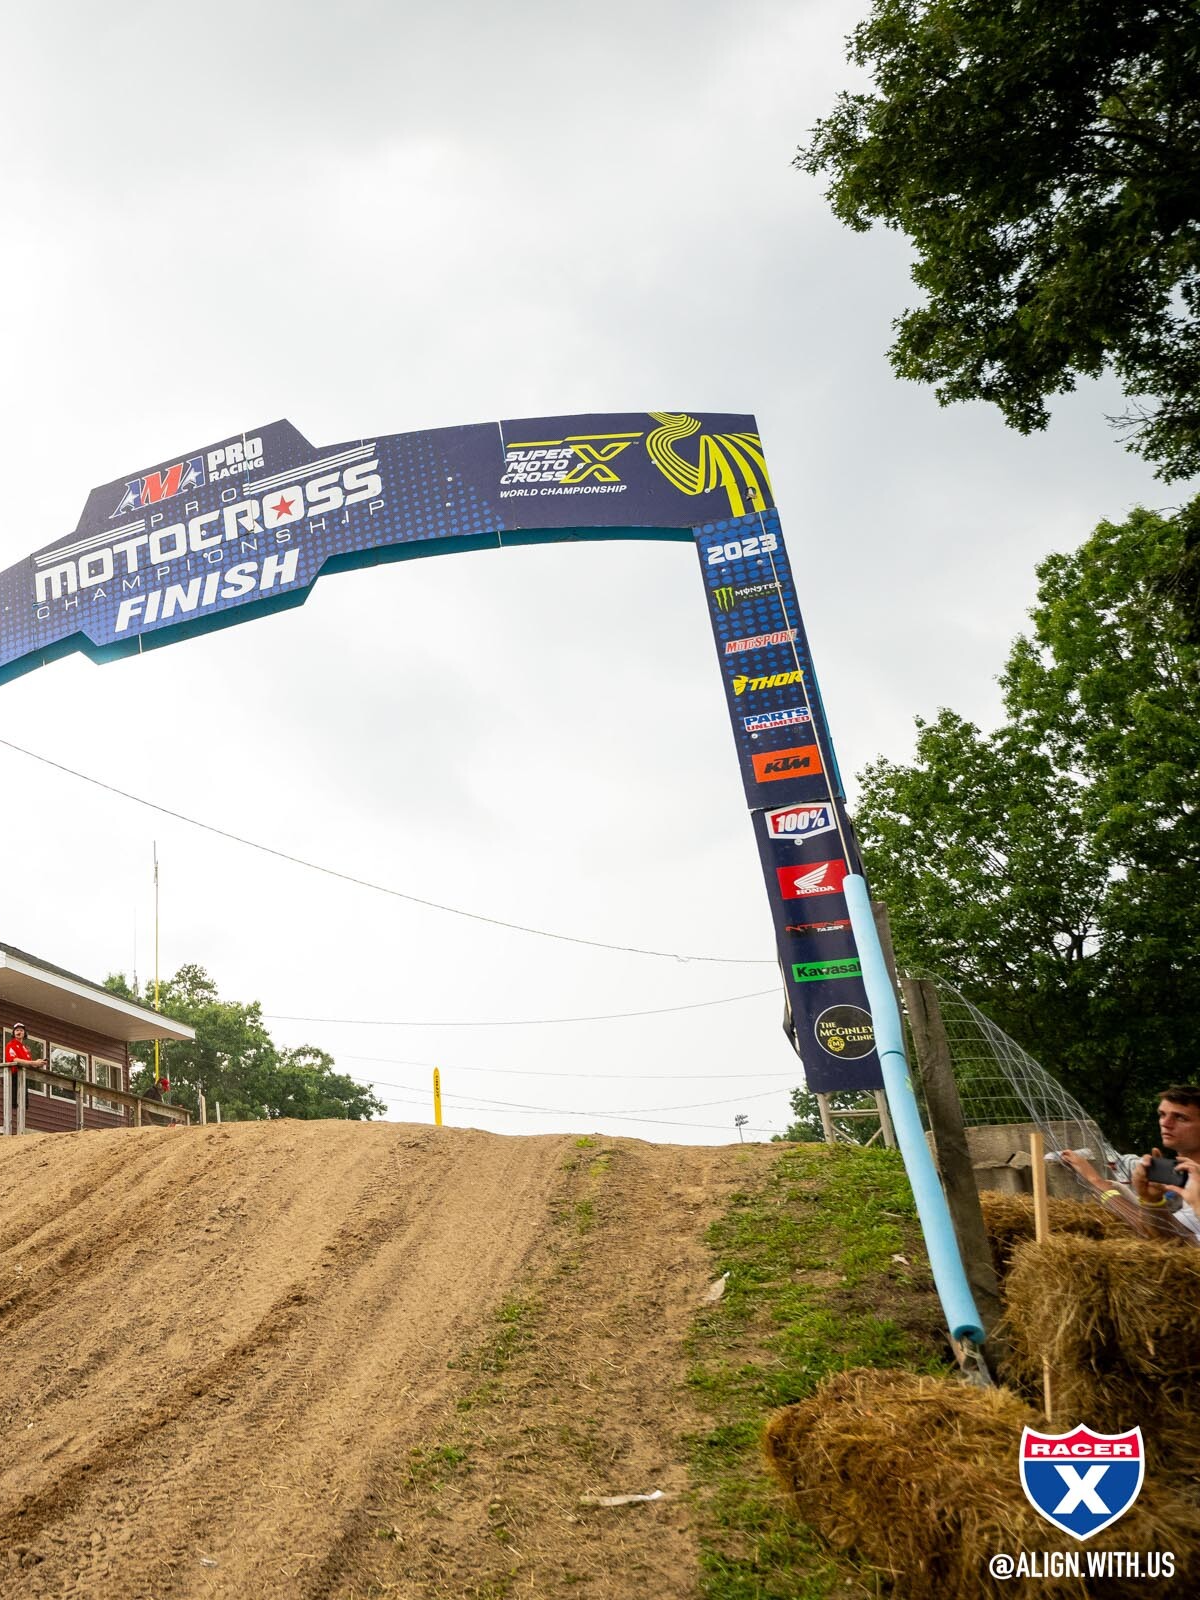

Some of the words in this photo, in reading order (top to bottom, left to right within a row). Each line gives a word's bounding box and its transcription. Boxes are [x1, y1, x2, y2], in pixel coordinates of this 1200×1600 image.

[207, 437, 263, 472] PRO
[506, 448, 574, 462] SUPER
[209, 457, 265, 483] RACING
[507, 459, 569, 474] MOTO
[500, 470, 569, 485] CROSS
[108, 455, 206, 519] AMA
[500, 488, 538, 498] WORLD
[540, 485, 628, 497] CHAMPIONSHIP
[35, 459, 383, 603] MOTOCROSS
[707, 533, 778, 565] 2023
[36, 499, 385, 620] CHAMPIONSHIP
[114, 548, 300, 633] FINISH
[735, 581, 783, 596] MONSTER
[749, 670, 804, 691] THOR
[745, 708, 809, 726] PARTS
[747, 715, 810, 731] UNLIMITED
[764, 756, 810, 774] KTM
[776, 809, 825, 833] 100%
[796, 886, 836, 896] HONDA
[819, 1021, 837, 1029] THE
[846, 1034, 874, 1042] CLINIC
